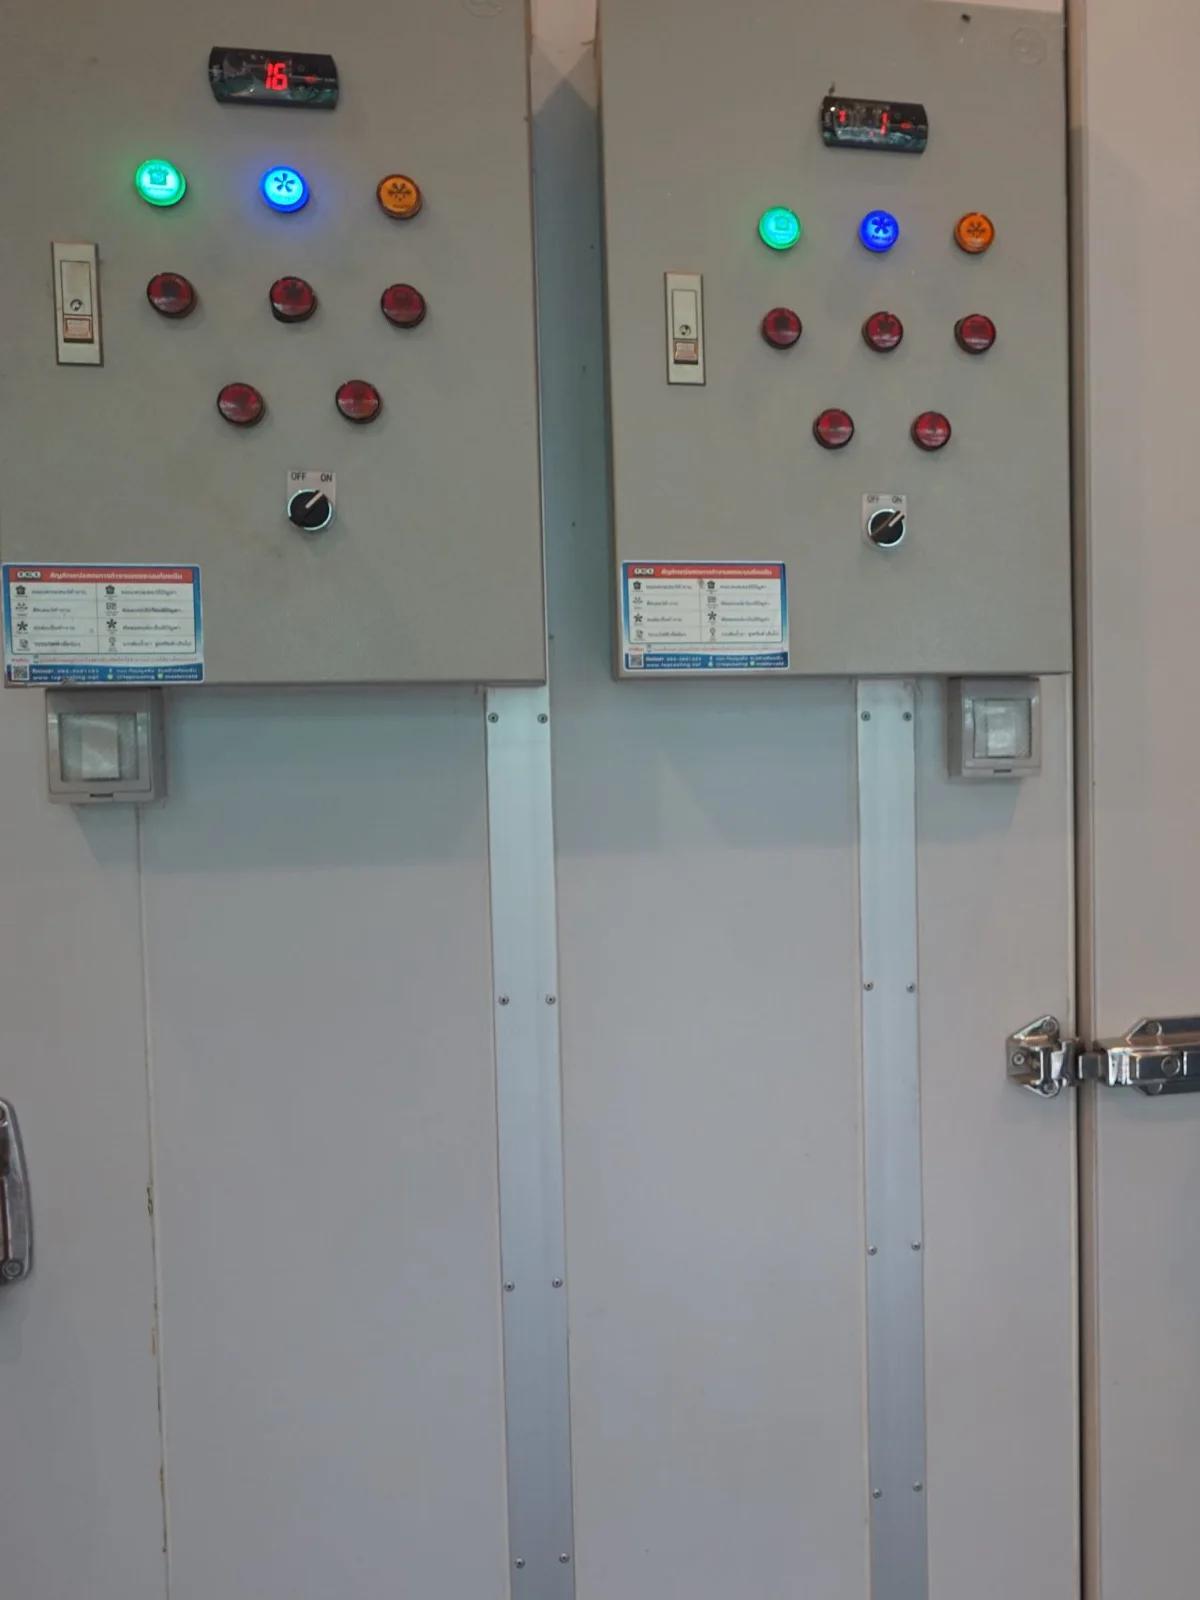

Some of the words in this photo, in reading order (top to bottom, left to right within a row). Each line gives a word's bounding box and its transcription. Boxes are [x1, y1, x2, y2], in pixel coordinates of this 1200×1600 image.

[265, 61, 288, 92] 16
[290, 471, 306, 481] OFF
[320, 472, 333, 482] ON
[891, 495, 903, 504] ON
